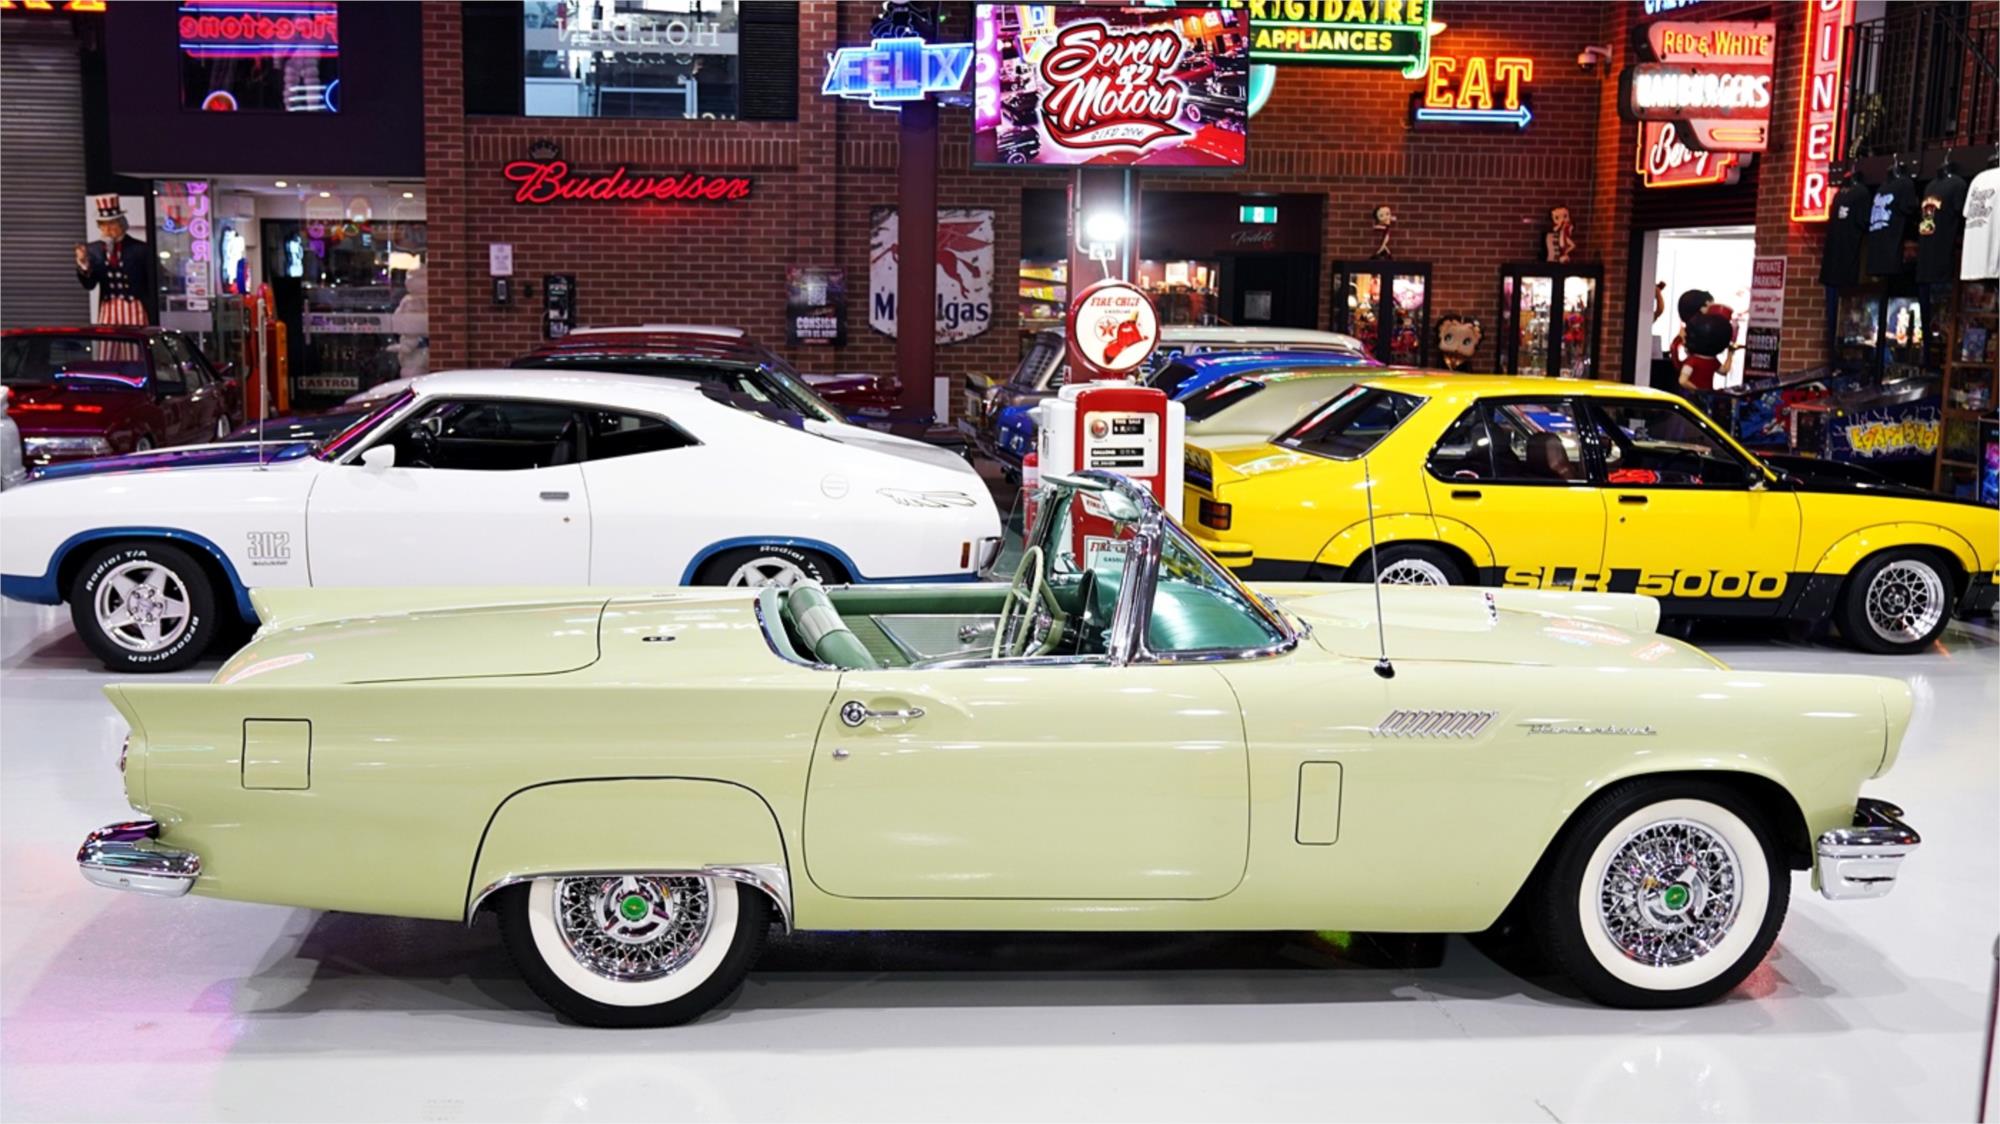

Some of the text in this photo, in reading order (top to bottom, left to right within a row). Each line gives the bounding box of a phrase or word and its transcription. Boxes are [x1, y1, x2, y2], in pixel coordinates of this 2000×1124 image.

[1047, 29, 1174, 83] Seven
[1255, 29, 1393, 52] APPLIANCES
[1663, 29, 1769, 56] RED & WHITE
[840, 51, 960, 91] FELIX
[1115, 63, 1154, 86] 82
[1426, 57, 1532, 109] EAT
[1049, 74, 1176, 130] Motors
[1636, 73, 1770, 108] HAMBURGERS
[503, 160, 751, 203] Budweiser
[796, 316, 837, 329] CONSIGN
[874, 292, 990, 330] Mlgas
[247, 531, 291, 560] 302
[760, 545, 805, 561] Radial
[85, 553, 121, 592] Radial
[1503, 566, 1787, 598] SLR 5000
